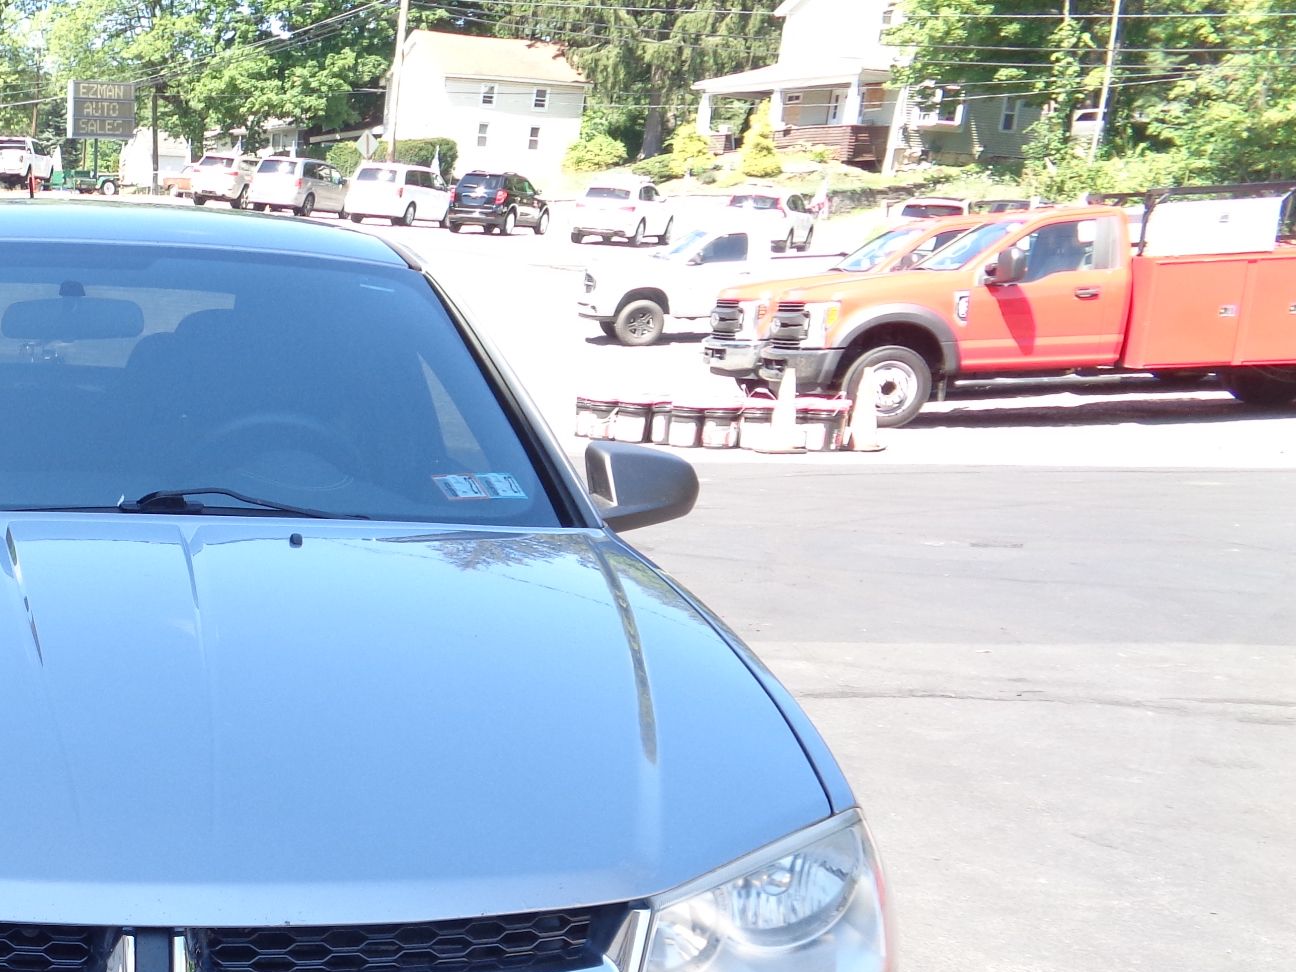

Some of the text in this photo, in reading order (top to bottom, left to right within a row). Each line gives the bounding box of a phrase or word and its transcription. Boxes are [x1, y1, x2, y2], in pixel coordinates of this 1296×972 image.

[79, 83, 124, 99] EZMAN
[83, 102, 119, 117] AUTO
[79, 119, 123, 134] SALES
